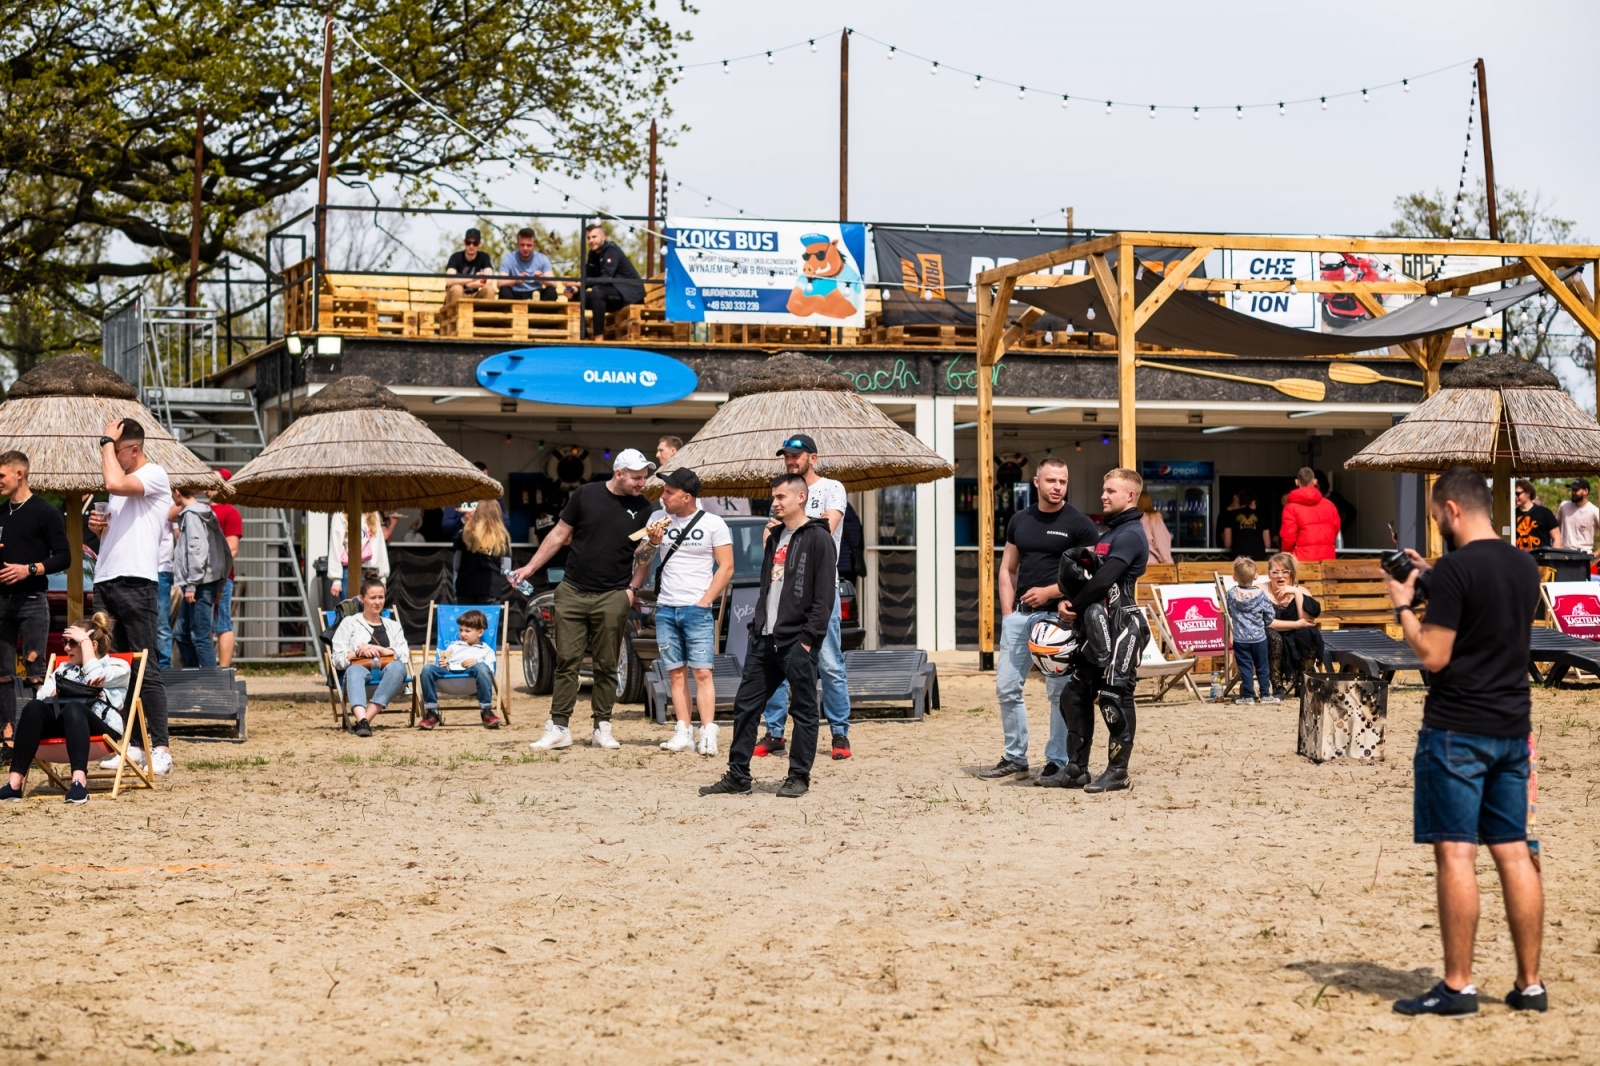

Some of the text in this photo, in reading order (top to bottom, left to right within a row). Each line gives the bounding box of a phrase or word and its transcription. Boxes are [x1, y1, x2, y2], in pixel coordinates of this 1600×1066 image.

[676, 229, 774, 250] KOKS BUS
[689, 264, 723, 273] WYNAJEM
[1249, 257, 1296, 275] CHE
[707, 301, 719, 311] +48
[720, 301, 733, 311] 530
[733, 301, 746, 311] 333
[1250, 295, 1289, 313] ION
[583, 369, 636, 384] OLAIAN
[1172, 467, 1198, 476] pepsi
[1175, 619, 1218, 632] KASZTELAN
